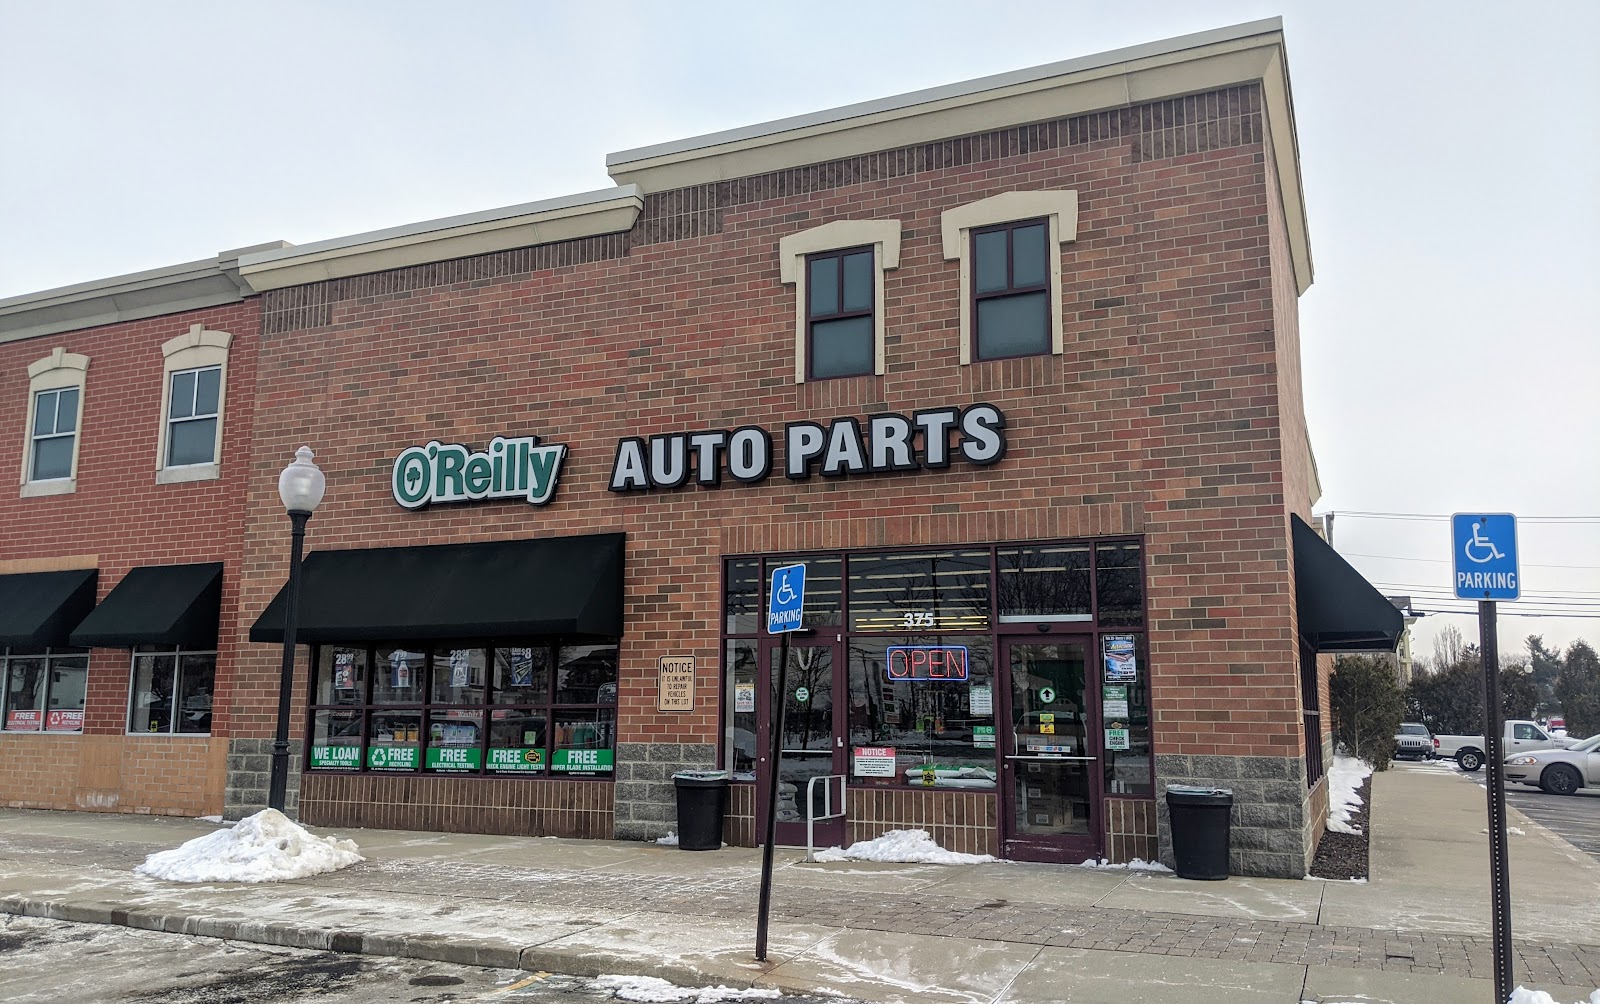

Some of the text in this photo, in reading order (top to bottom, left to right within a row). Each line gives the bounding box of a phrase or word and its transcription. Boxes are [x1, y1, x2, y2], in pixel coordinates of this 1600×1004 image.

[396, 407, 1000, 503] O'Reilly AUTO PARTS
[1457, 571, 1516, 589] PARKING
[770, 608, 801, 625] PARKING
[903, 613, 934, 627] 375
[662, 662, 692, 673] NOTICE
[890, 650, 965, 677] OPEN
[14, 712, 36, 720] FREE
[60, 712, 84, 720] FREE
[314, 747, 359, 760] WE LOAN
[387, 748, 414, 761] FREE
[440, 748, 468, 762] FREE
[492, 749, 521, 763] FREE
[567, 750, 598, 764] FREE
[862, 748, 887, 756] NOTICE
